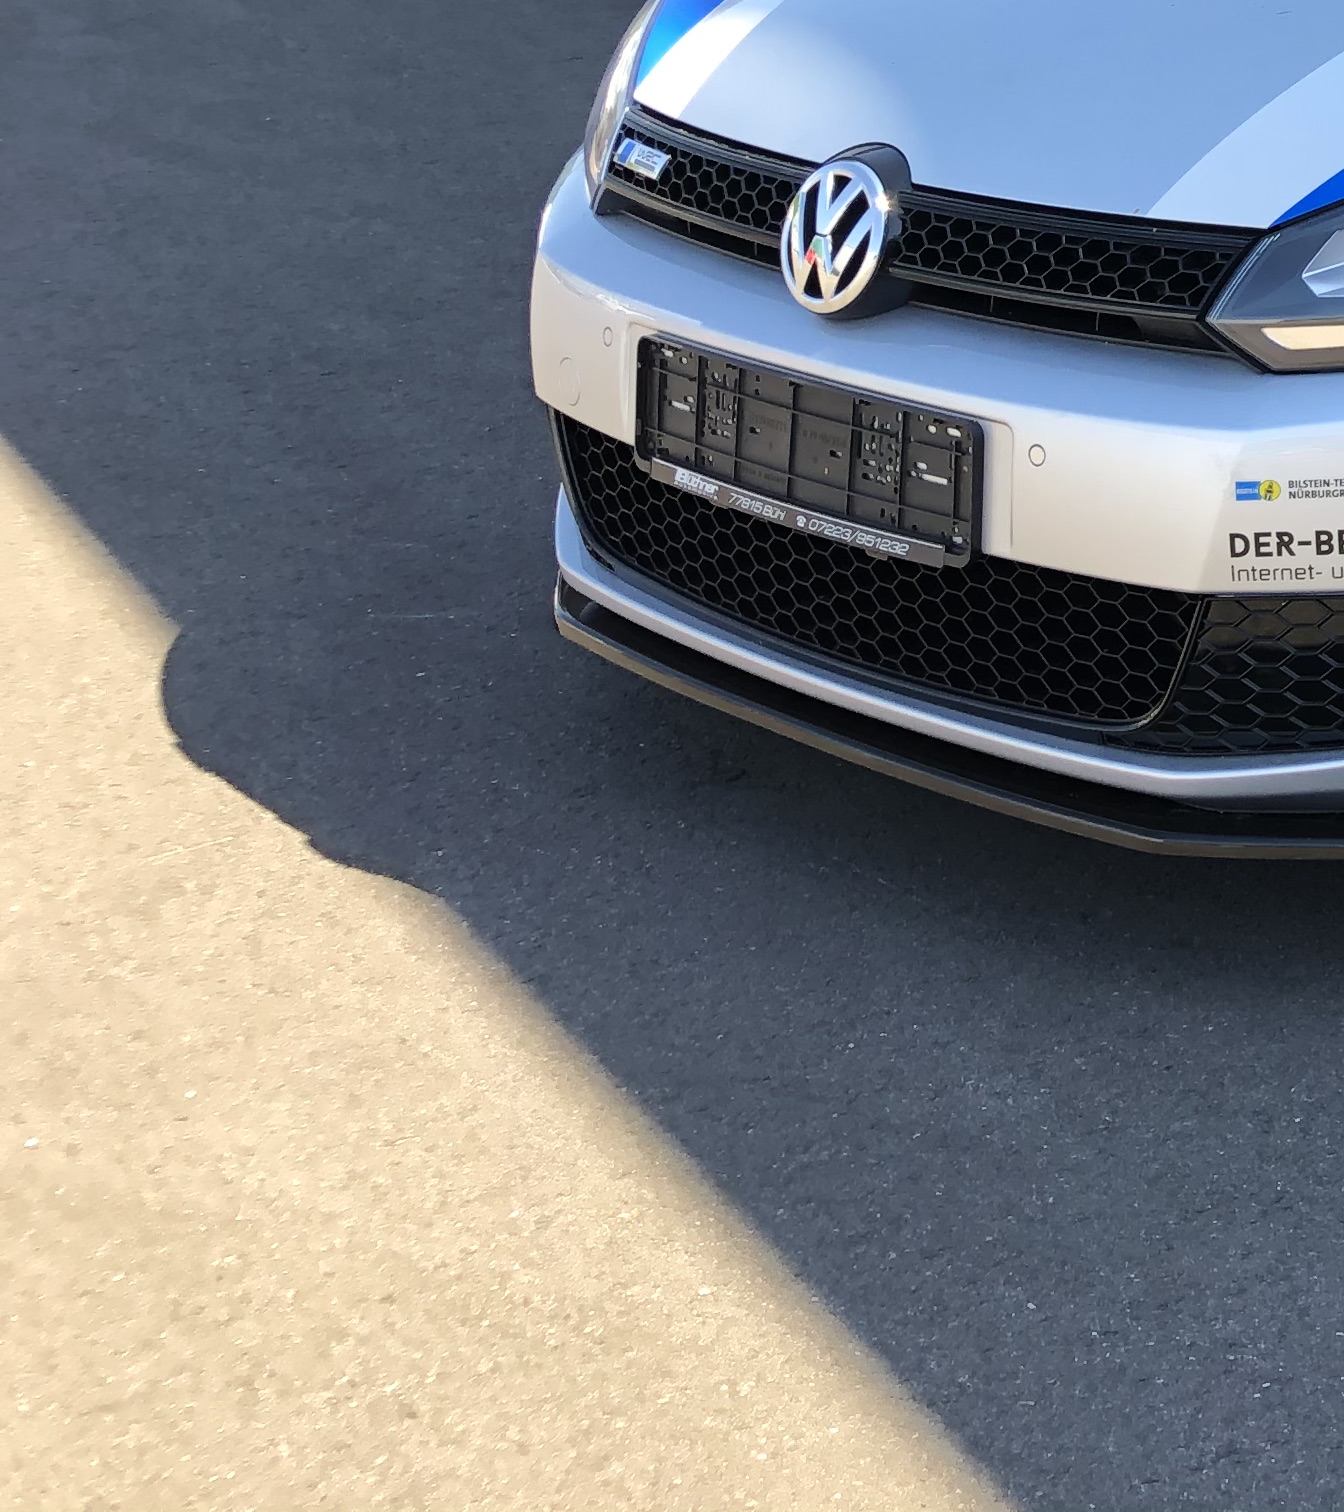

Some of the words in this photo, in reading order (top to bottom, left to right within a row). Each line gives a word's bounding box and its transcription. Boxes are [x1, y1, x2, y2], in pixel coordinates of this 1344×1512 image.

[728, 492, 764, 514] 77815
[808, 518, 910, 555] 07223/951232
[1230, 563, 1323, 582] Internet-
